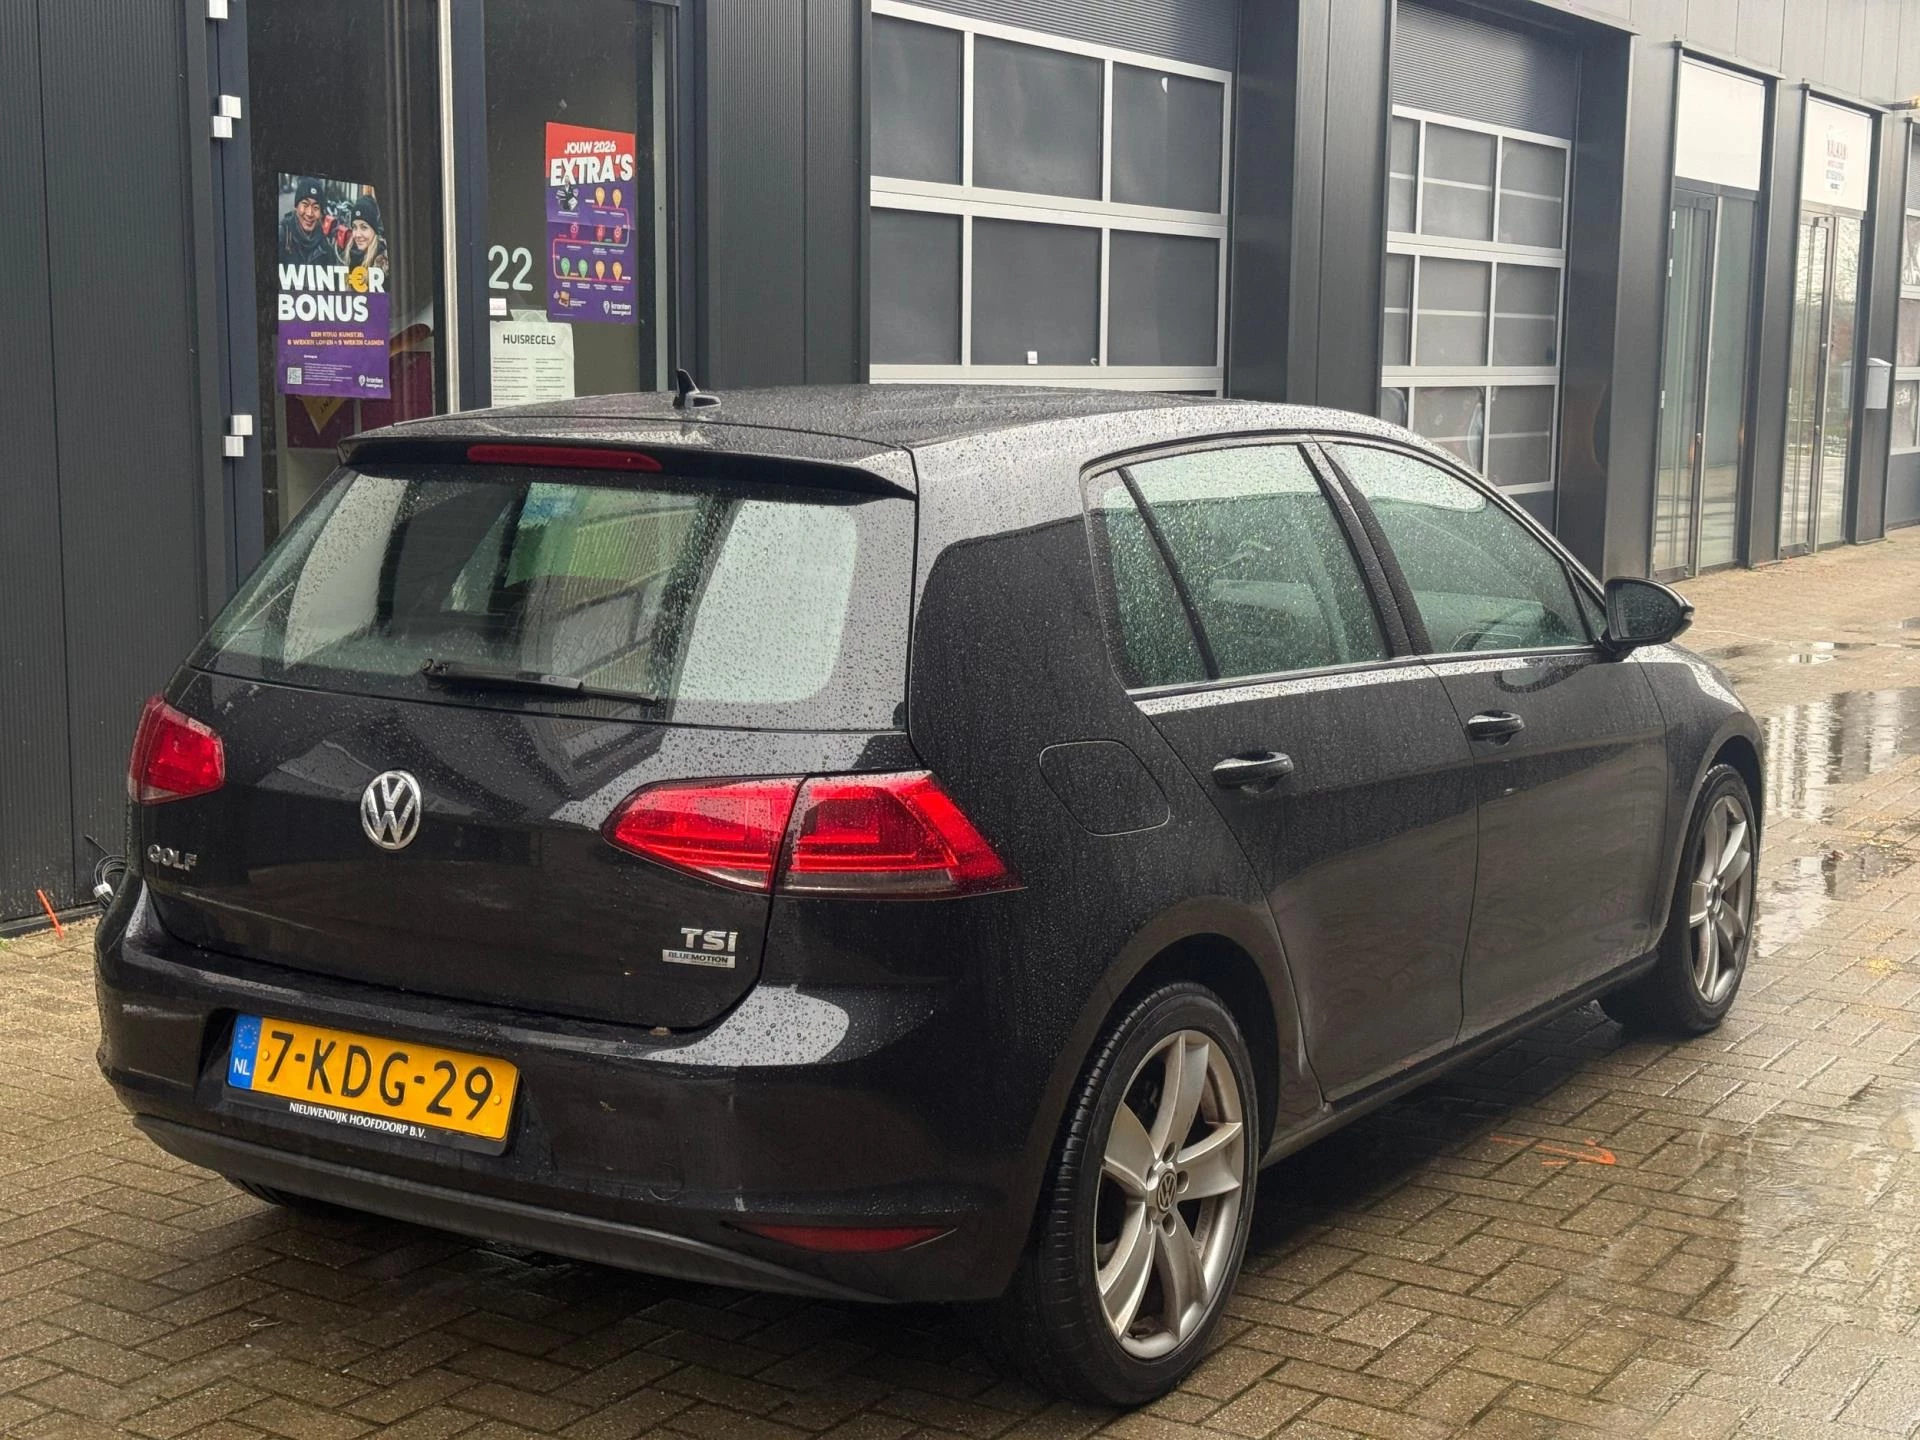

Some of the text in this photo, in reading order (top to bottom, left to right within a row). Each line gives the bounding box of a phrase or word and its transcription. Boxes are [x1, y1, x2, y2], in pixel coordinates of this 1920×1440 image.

[564, 140, 617, 154] JOUW 2026
[550, 153, 634, 187] EXTRA'S
[488, 245, 533, 291] 22
[278, 293, 369, 323] BONUS
[502, 334, 556, 345] HUISREGELS
[361, 769, 422, 850] VW
[147, 844, 198, 871] GOLF
[680, 927, 739, 952] TSI
[668, 951, 729, 964] BLUEMOTION
[233, 1057, 250, 1076] NL
[267, 1030, 494, 1121] 7-KDG-29
[289, 1102, 427, 1139] NIEUWENDIJK HOOFDDORP B.V.
